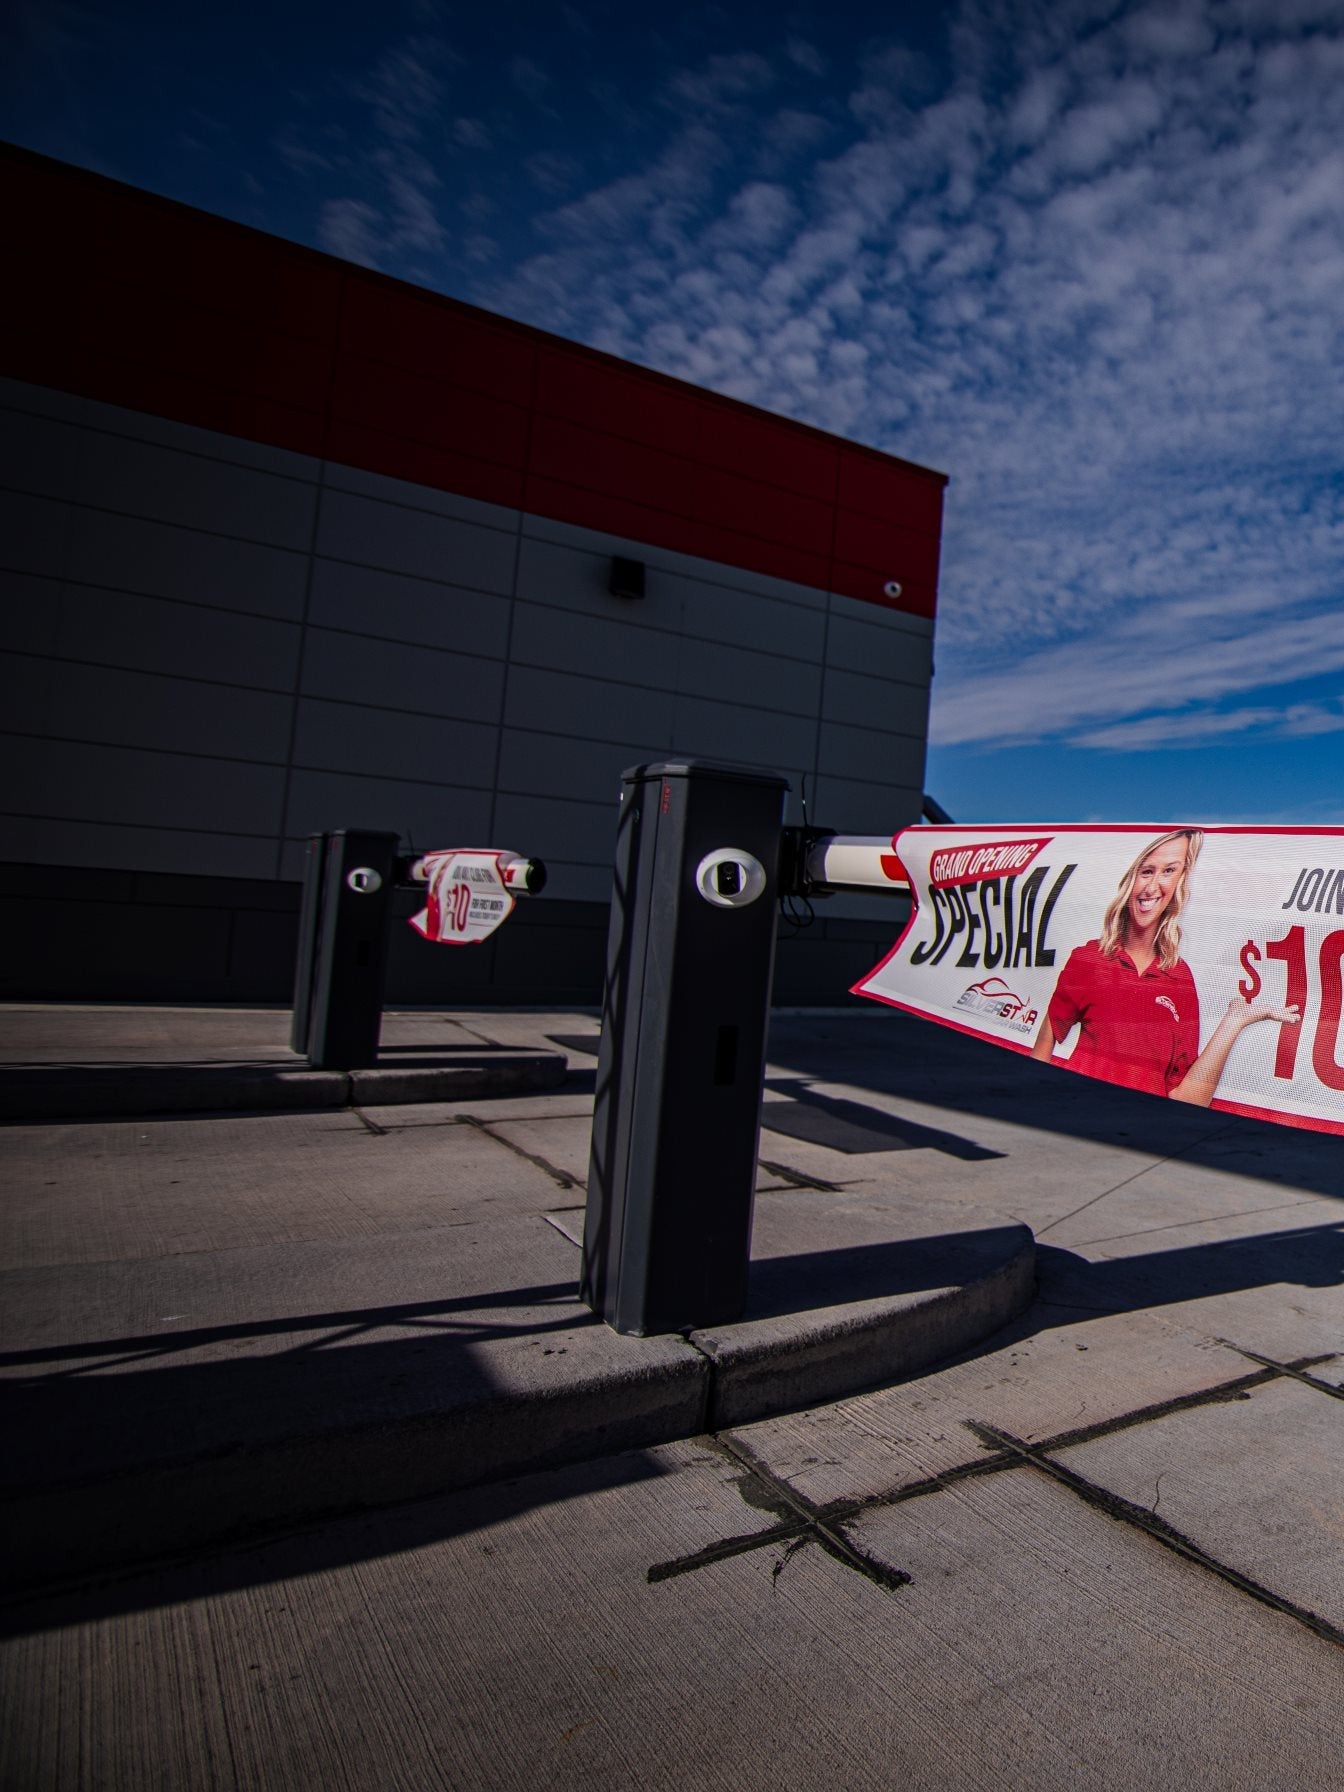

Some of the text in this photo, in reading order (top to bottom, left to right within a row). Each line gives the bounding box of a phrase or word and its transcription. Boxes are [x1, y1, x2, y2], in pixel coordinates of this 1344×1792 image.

[934, 843, 1039, 882] GRAND OPENING
[910, 864, 1078, 969] SPECIAL
